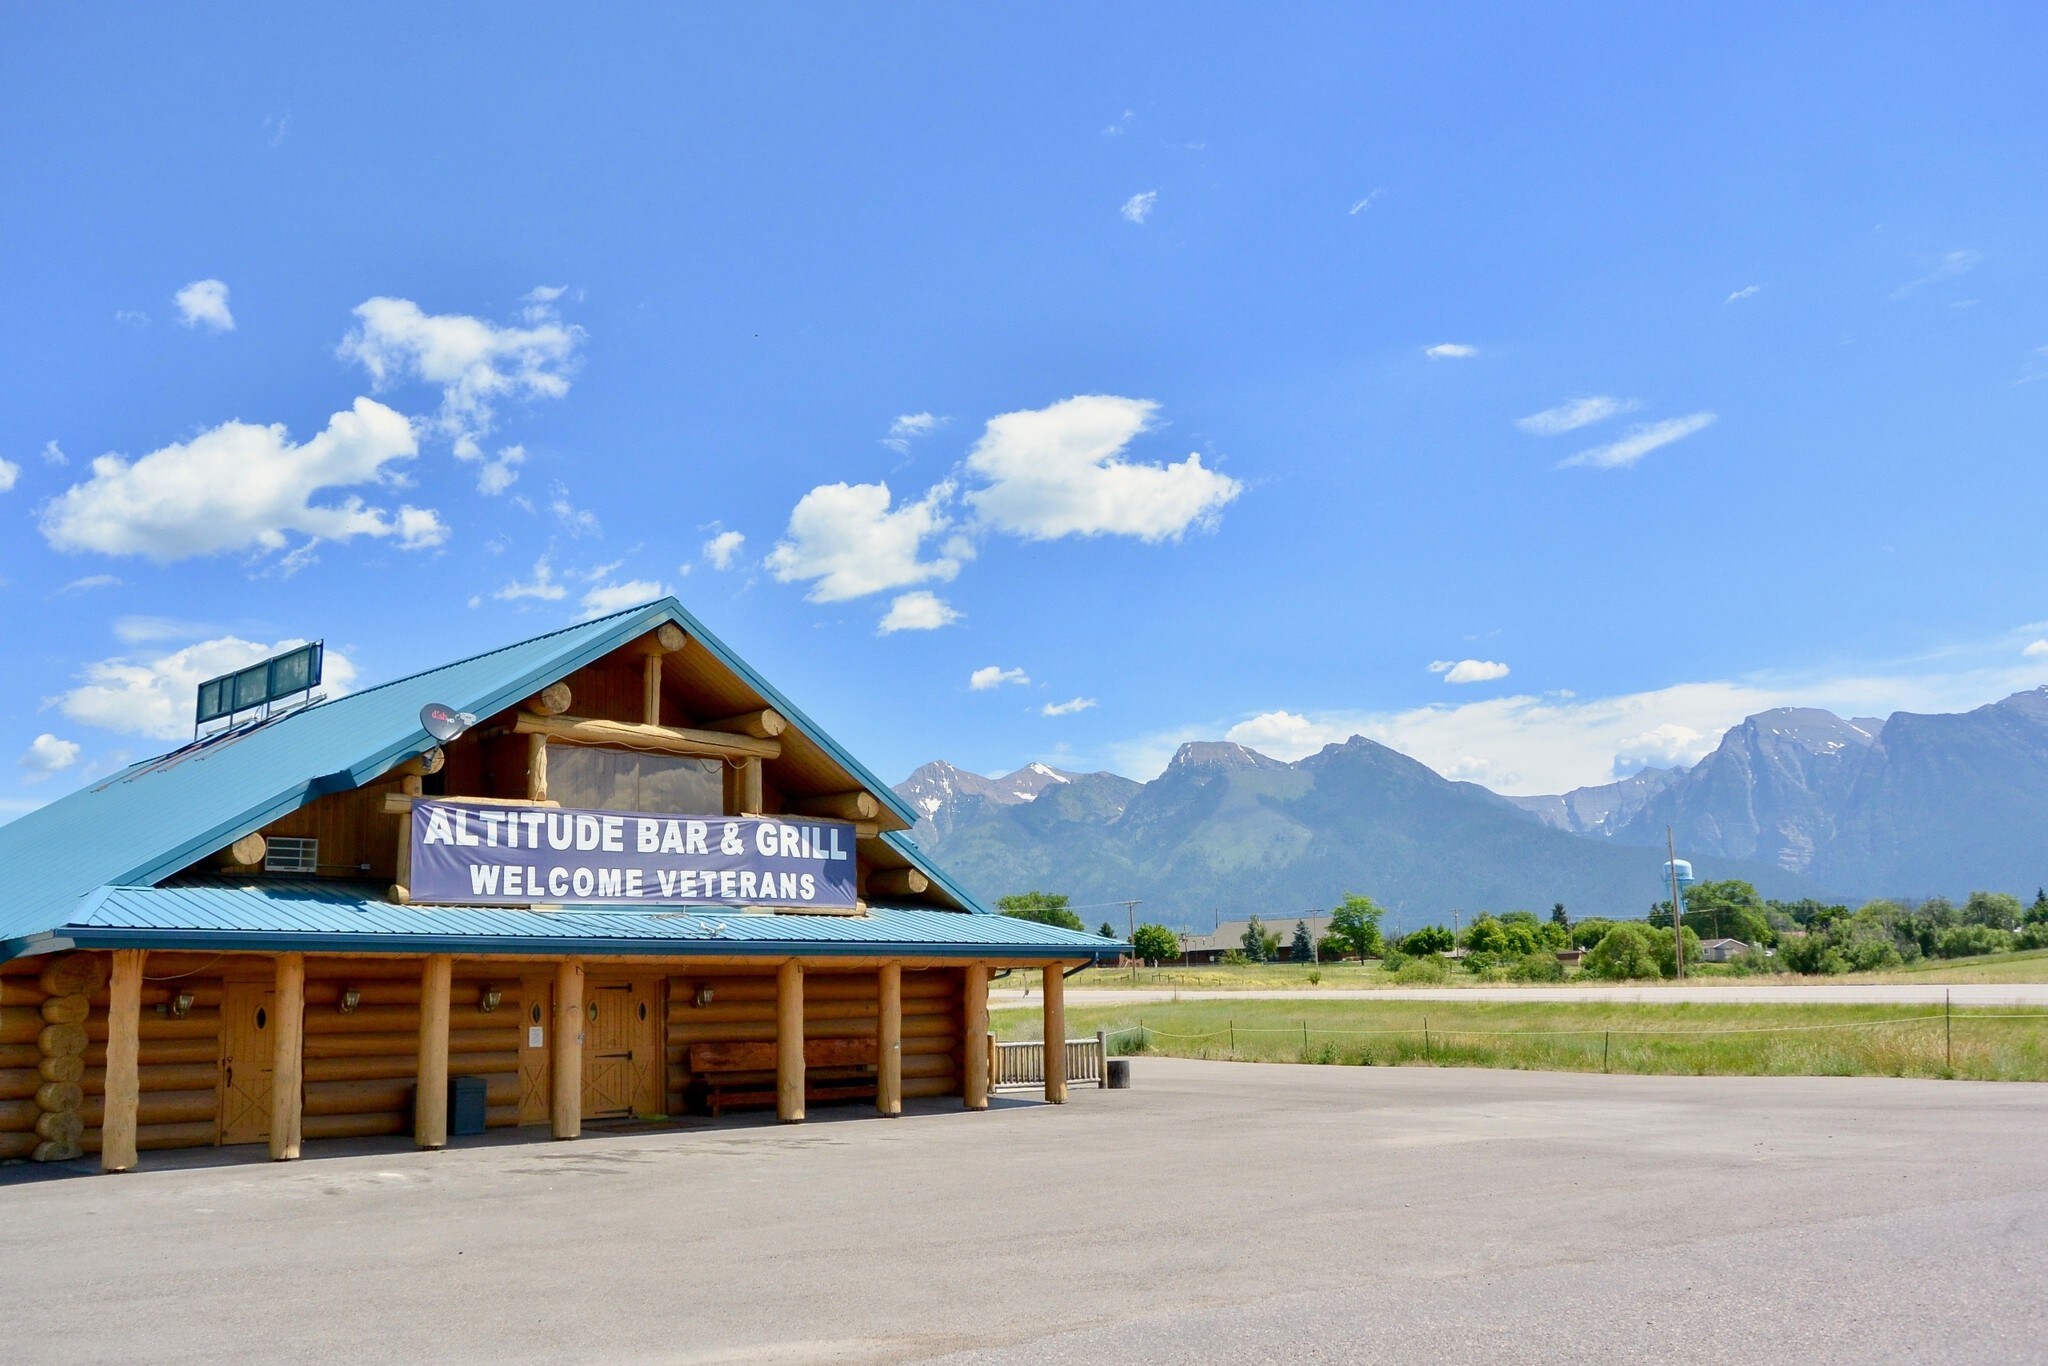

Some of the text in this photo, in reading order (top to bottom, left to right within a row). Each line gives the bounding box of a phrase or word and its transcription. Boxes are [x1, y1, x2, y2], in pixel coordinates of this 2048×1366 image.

[423, 807, 847, 861] ALTITUDE BAR & GRILL
[469, 864, 816, 901] WELCOME VETERANS
